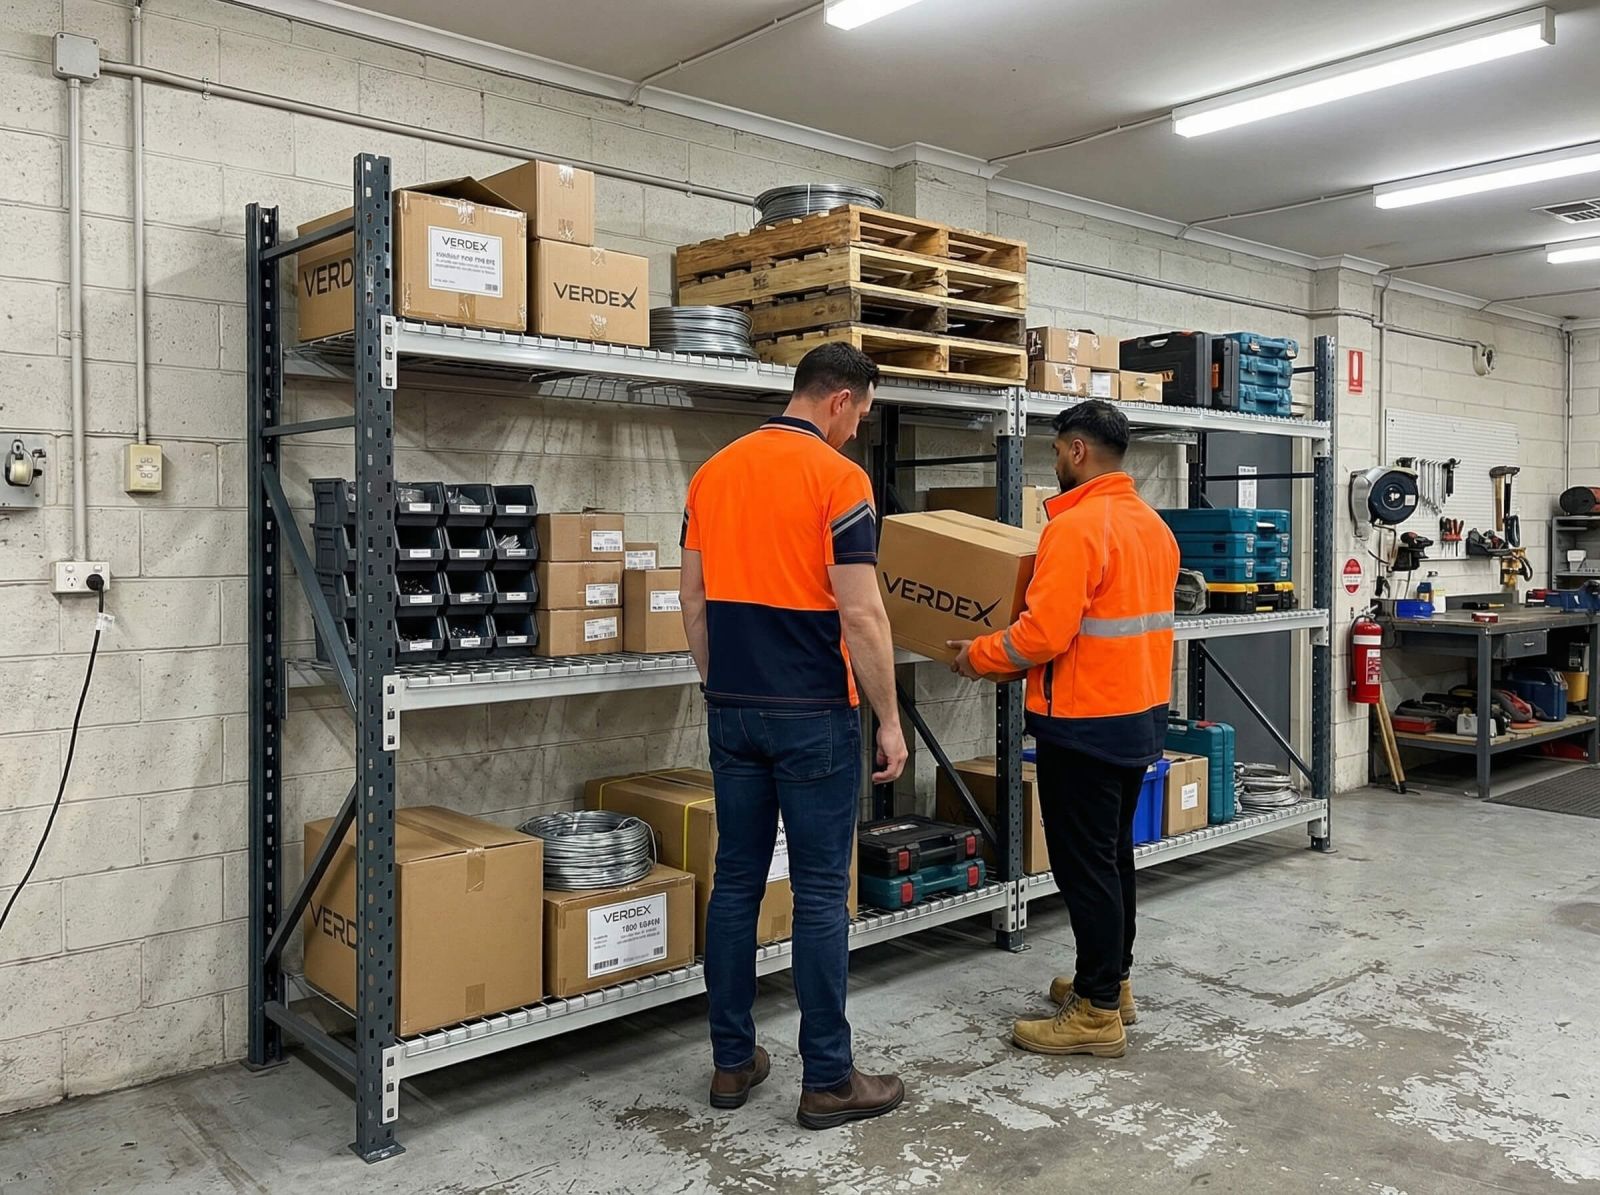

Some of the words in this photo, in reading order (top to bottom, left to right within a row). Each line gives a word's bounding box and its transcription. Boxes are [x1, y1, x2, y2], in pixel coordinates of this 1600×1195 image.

[442, 236, 489, 252] VERDEX
[553, 282, 638, 310] VERDEX
[882, 571, 1002, 628] VERDEX
[603, 904, 651, 924] VERDEX
